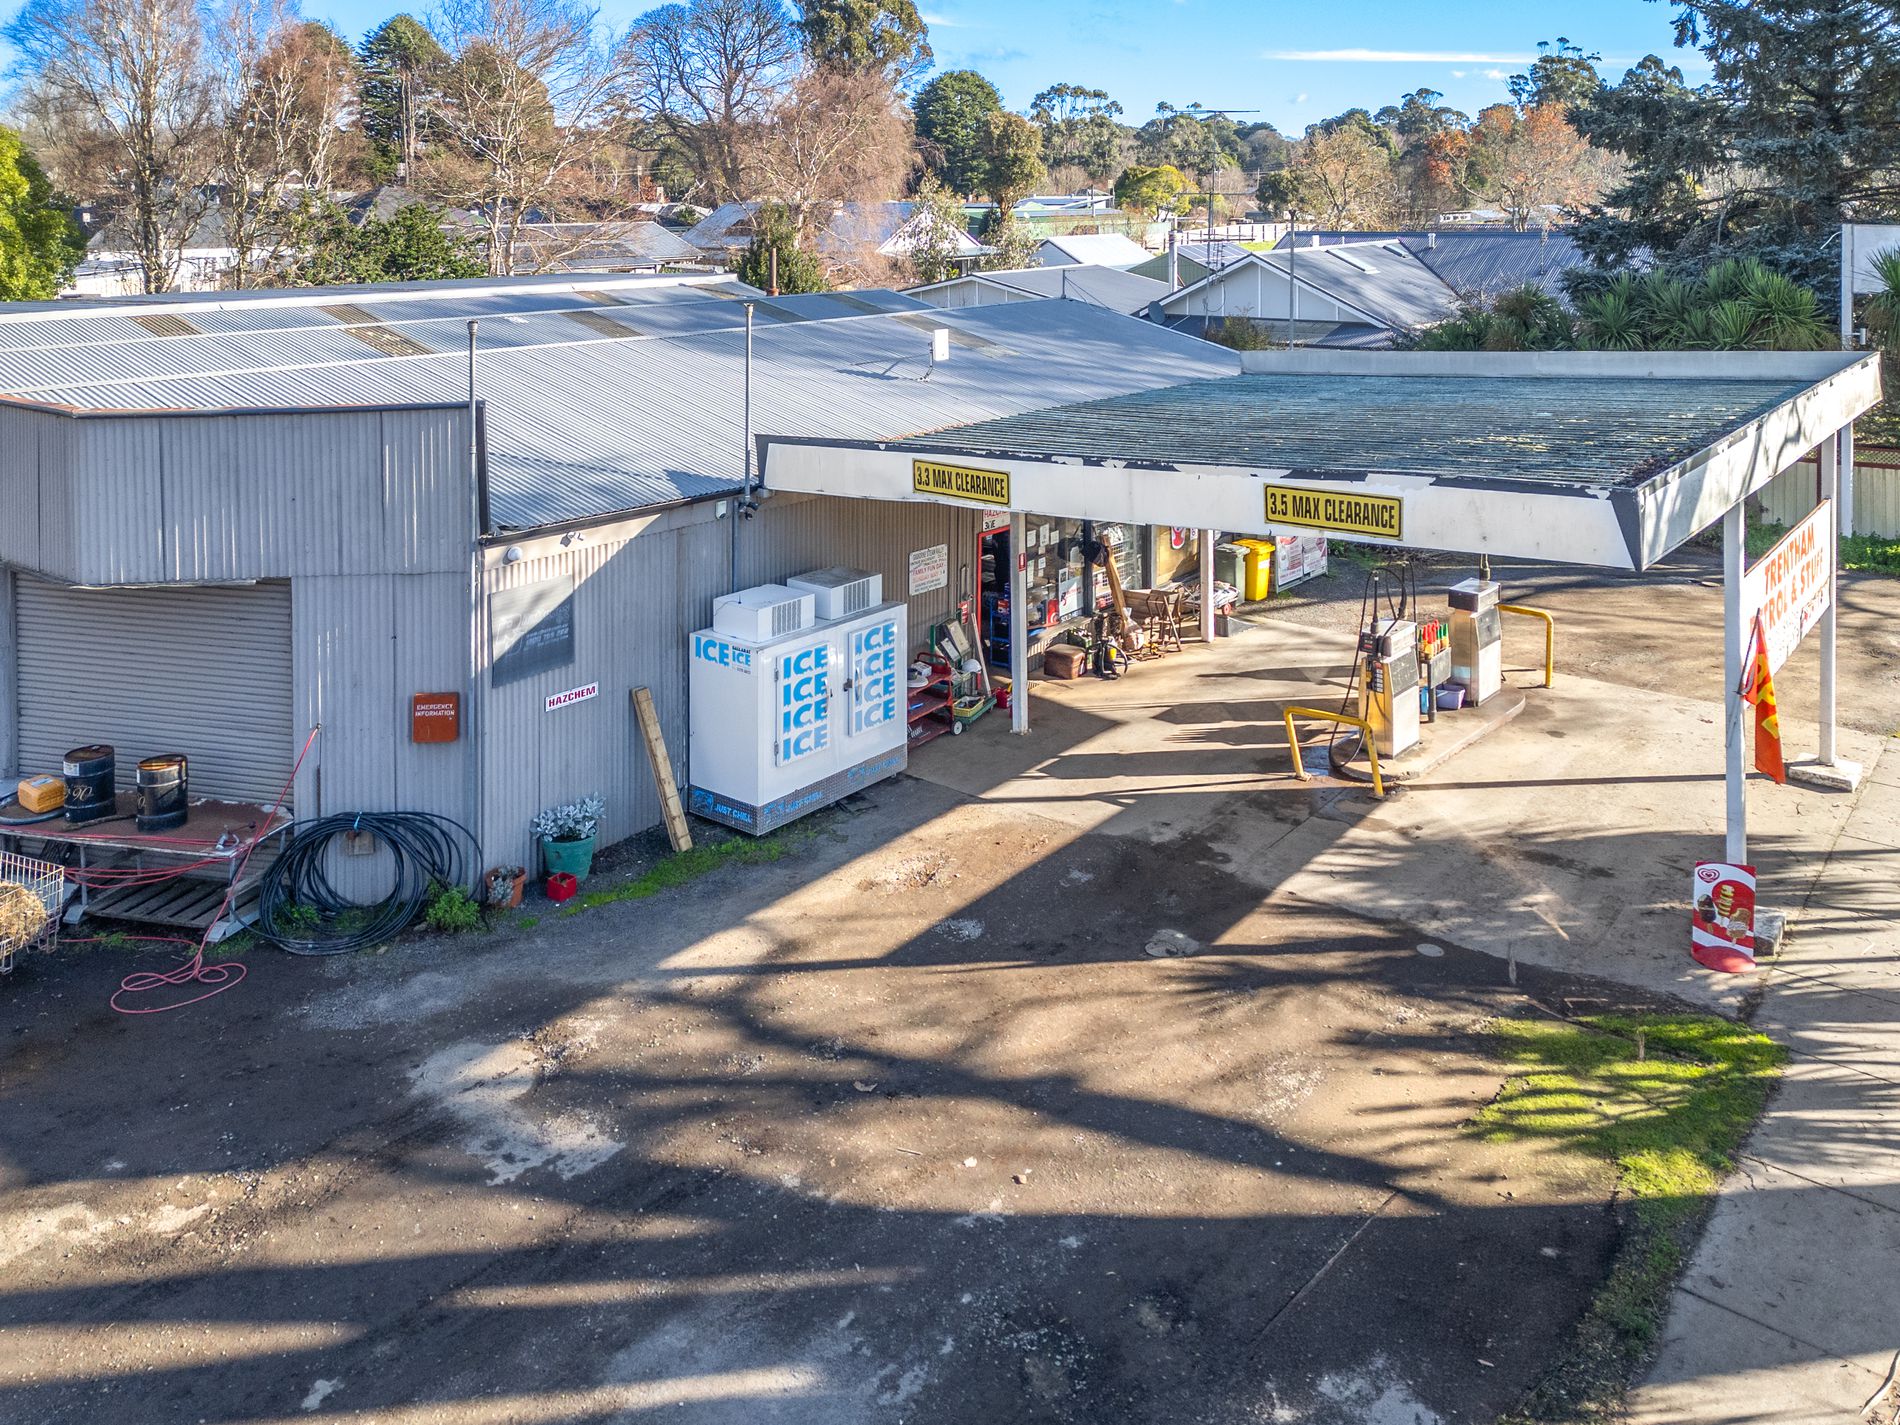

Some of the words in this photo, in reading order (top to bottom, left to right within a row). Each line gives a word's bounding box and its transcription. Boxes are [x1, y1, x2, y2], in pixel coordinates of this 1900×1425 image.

[917, 466, 930, 486] 3.3
[932, 468, 953, 490] MAX
[955, 472, 1005, 498] CLEARANCE
[1270, 492, 1288, 516] 3.5
[1292, 495, 1320, 520] MAX
[1324, 498, 1395, 529] CLEARANCE
[1765, 522, 1815, 596] TRENTHAM
[1750, 585, 1788, 636] PTROL
[1791, 574, 1798, 606] &
[1800, 547, 1824, 596] STUFF
[695, 636, 729, 667] ICE
[854, 622, 895, 656] ICE
[732, 651, 751, 667] ICE
[783, 644, 828, 680] ICE
[854, 647, 895, 681] ICE
[548, 685, 596, 708] HAZCHEM
[783, 671, 828, 708] ICE
[854, 672, 895, 707] ICE
[415, 709, 455, 717] INFORMATION
[416, 703, 454, 711] EMERGENCY
[783, 697, 828, 735] ICE
[854, 697, 895, 733] ICE
[783, 723, 828, 762] ICE
[714, 803, 730, 816] JUST
